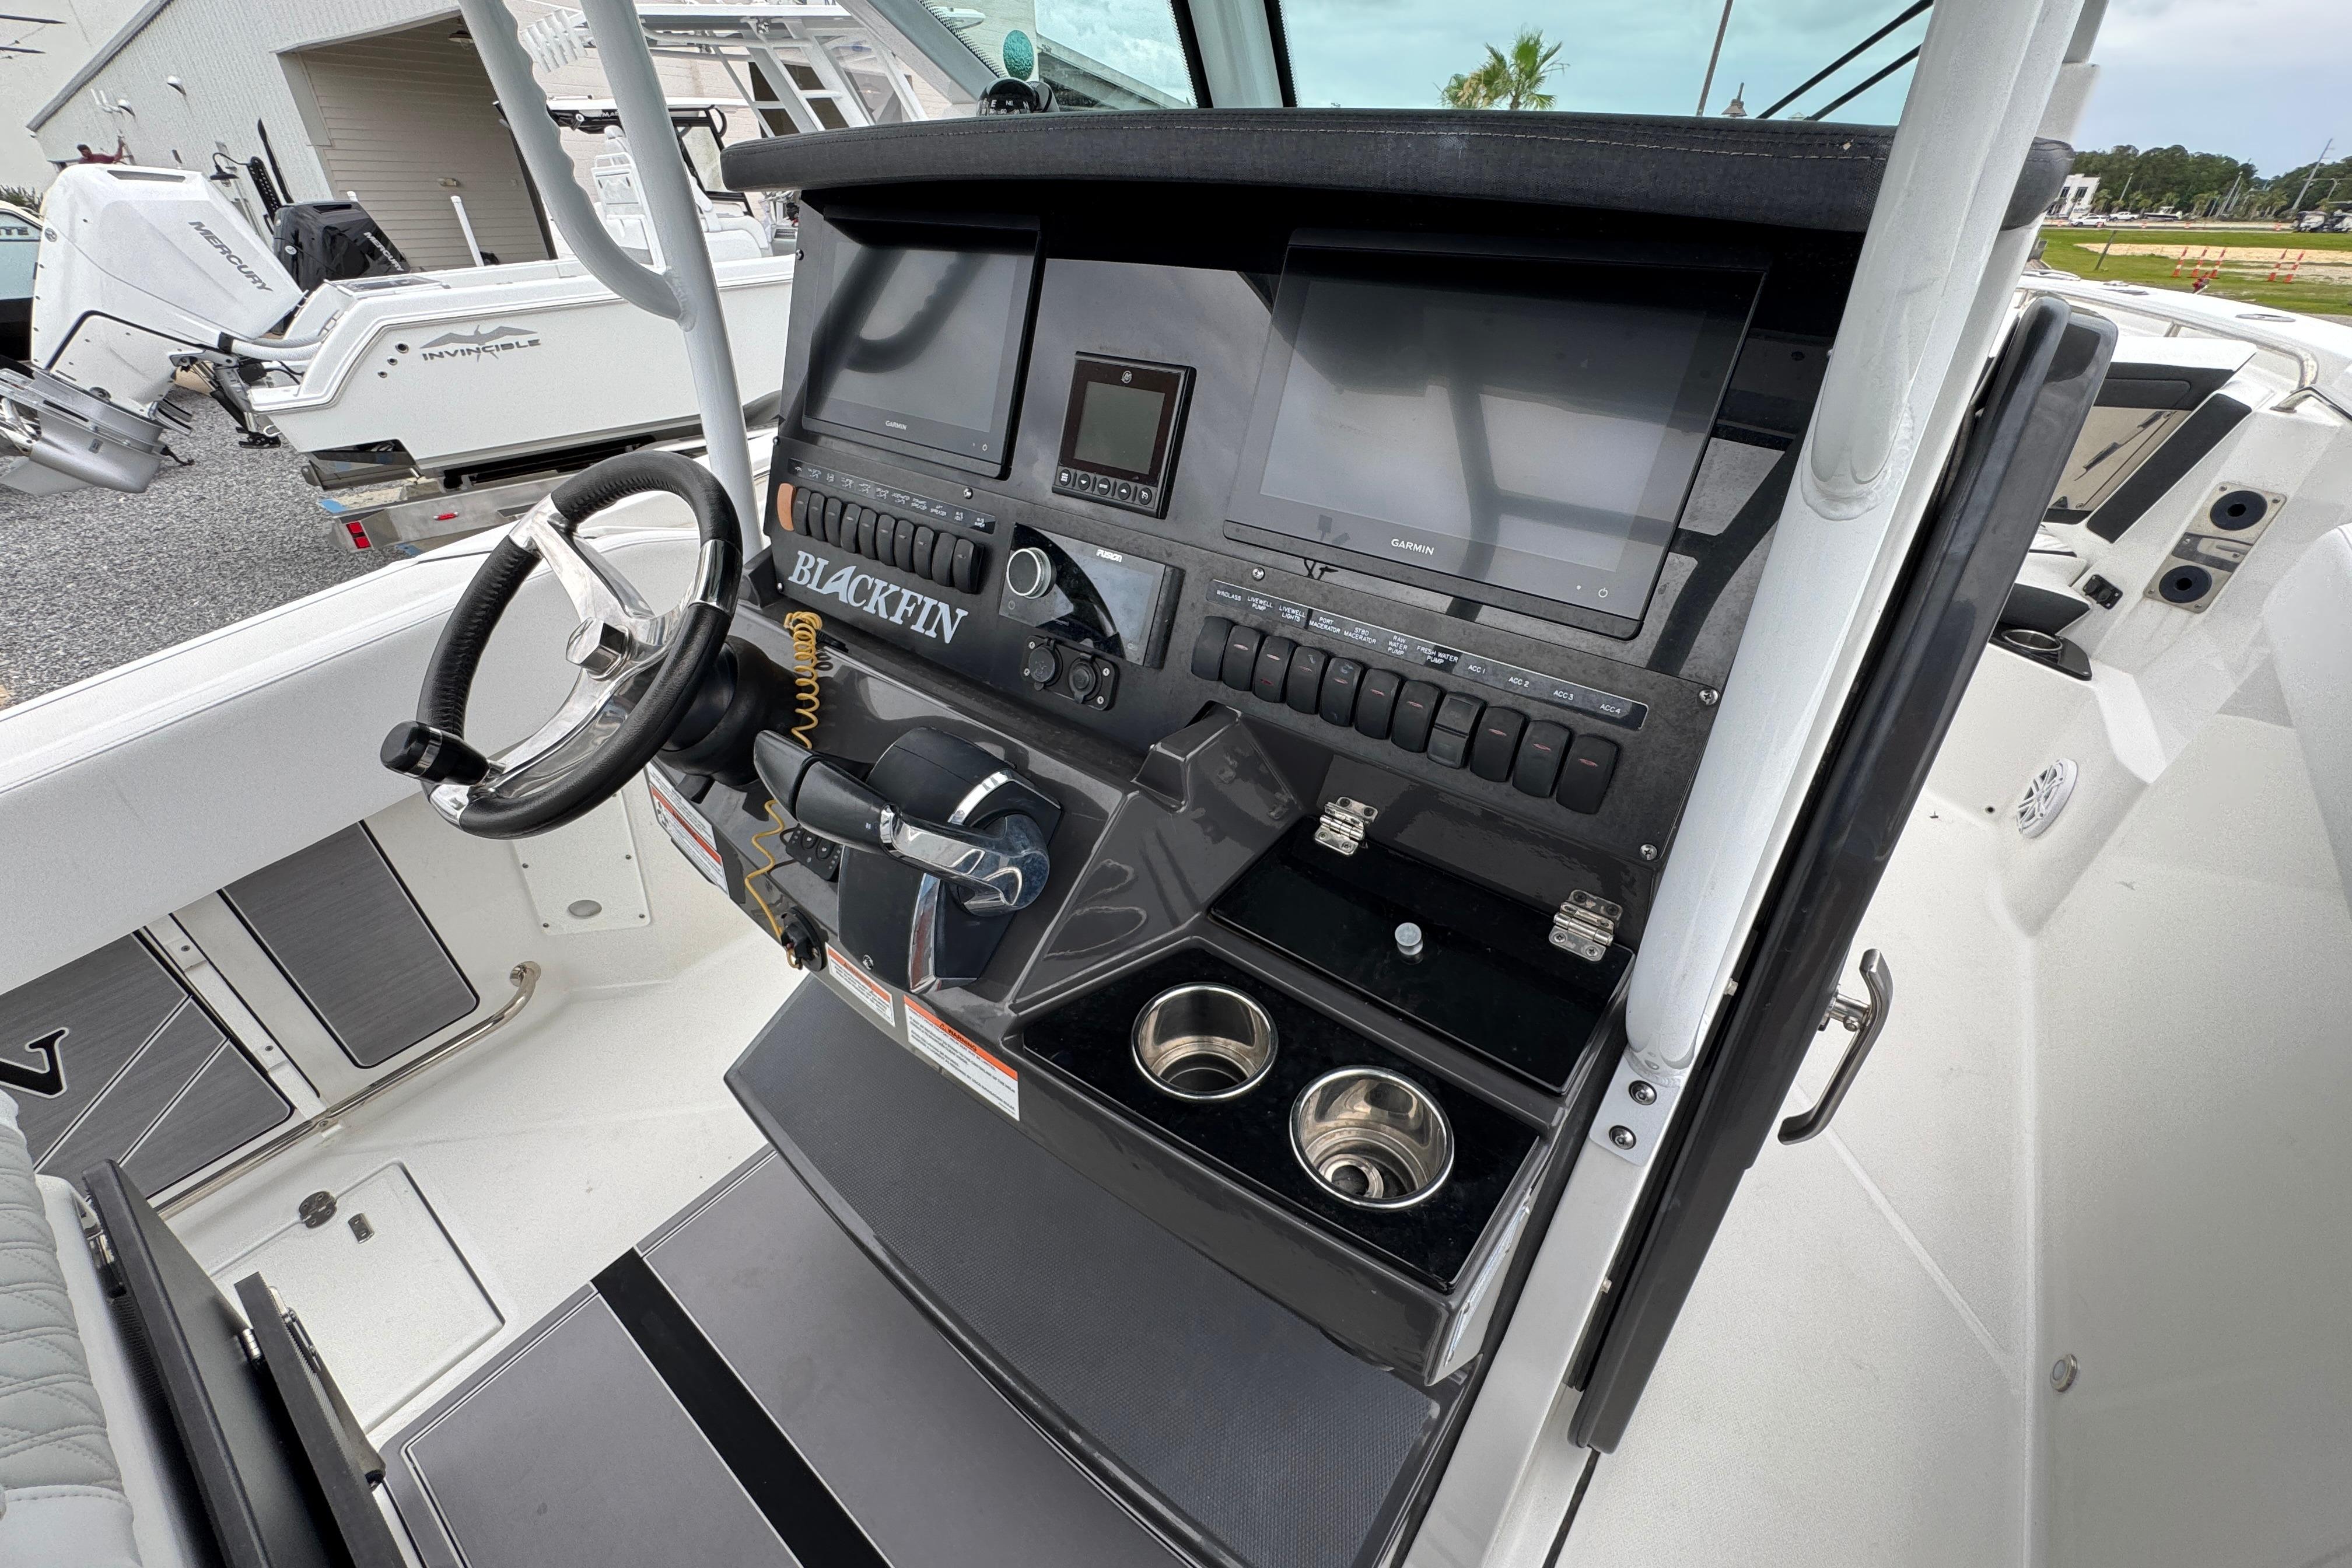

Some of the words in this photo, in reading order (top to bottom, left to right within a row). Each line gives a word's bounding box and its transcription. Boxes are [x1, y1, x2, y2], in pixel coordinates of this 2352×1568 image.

[188, 220, 274, 293] MERCURY
[362, 231, 406, 273] MERCURY
[422, 338, 541, 362] INVINCIBLE
[885, 420, 907, 430] GARMIN
[1390, 538, 1435, 556] GARMIN
[1096, 548, 1123, 564] FUSION
[788, 550, 969, 645] BLACKFIN
[1216, 589, 1241, 602] WINDLASS
[1247, 596, 1273, 608] LIVEWELL
[1252, 603, 1266, 611] PUMP
[1279, 605, 1306, 618] LIVEWELL
[1282, 612, 1300, 622] LIGHTS
[1319, 616, 1334, 625] PORT
[1309, 620, 1340, 634] MACERATOR
[1354, 627, 1370, 636] STBD
[1343, 630, 1377, 645] MACERATOR
[1393, 635, 1406, 644] RAW
[1388, 640, 1408, 651] WATER
[1387, 647, 1404, 656] PUMP
[1416, 645, 1436, 656] FRESH
[1438, 651, 1458, 663] WATER
[1426, 655, 1444, 664] PUMP
[1468, 664, 1482, 674] ACC
[1508, 676, 1523, 686] ACC
[1553, 690, 1567, 699] ACC
[1600, 703, 1614, 713] ACC
[947, 1028, 977, 1052] WARNING
